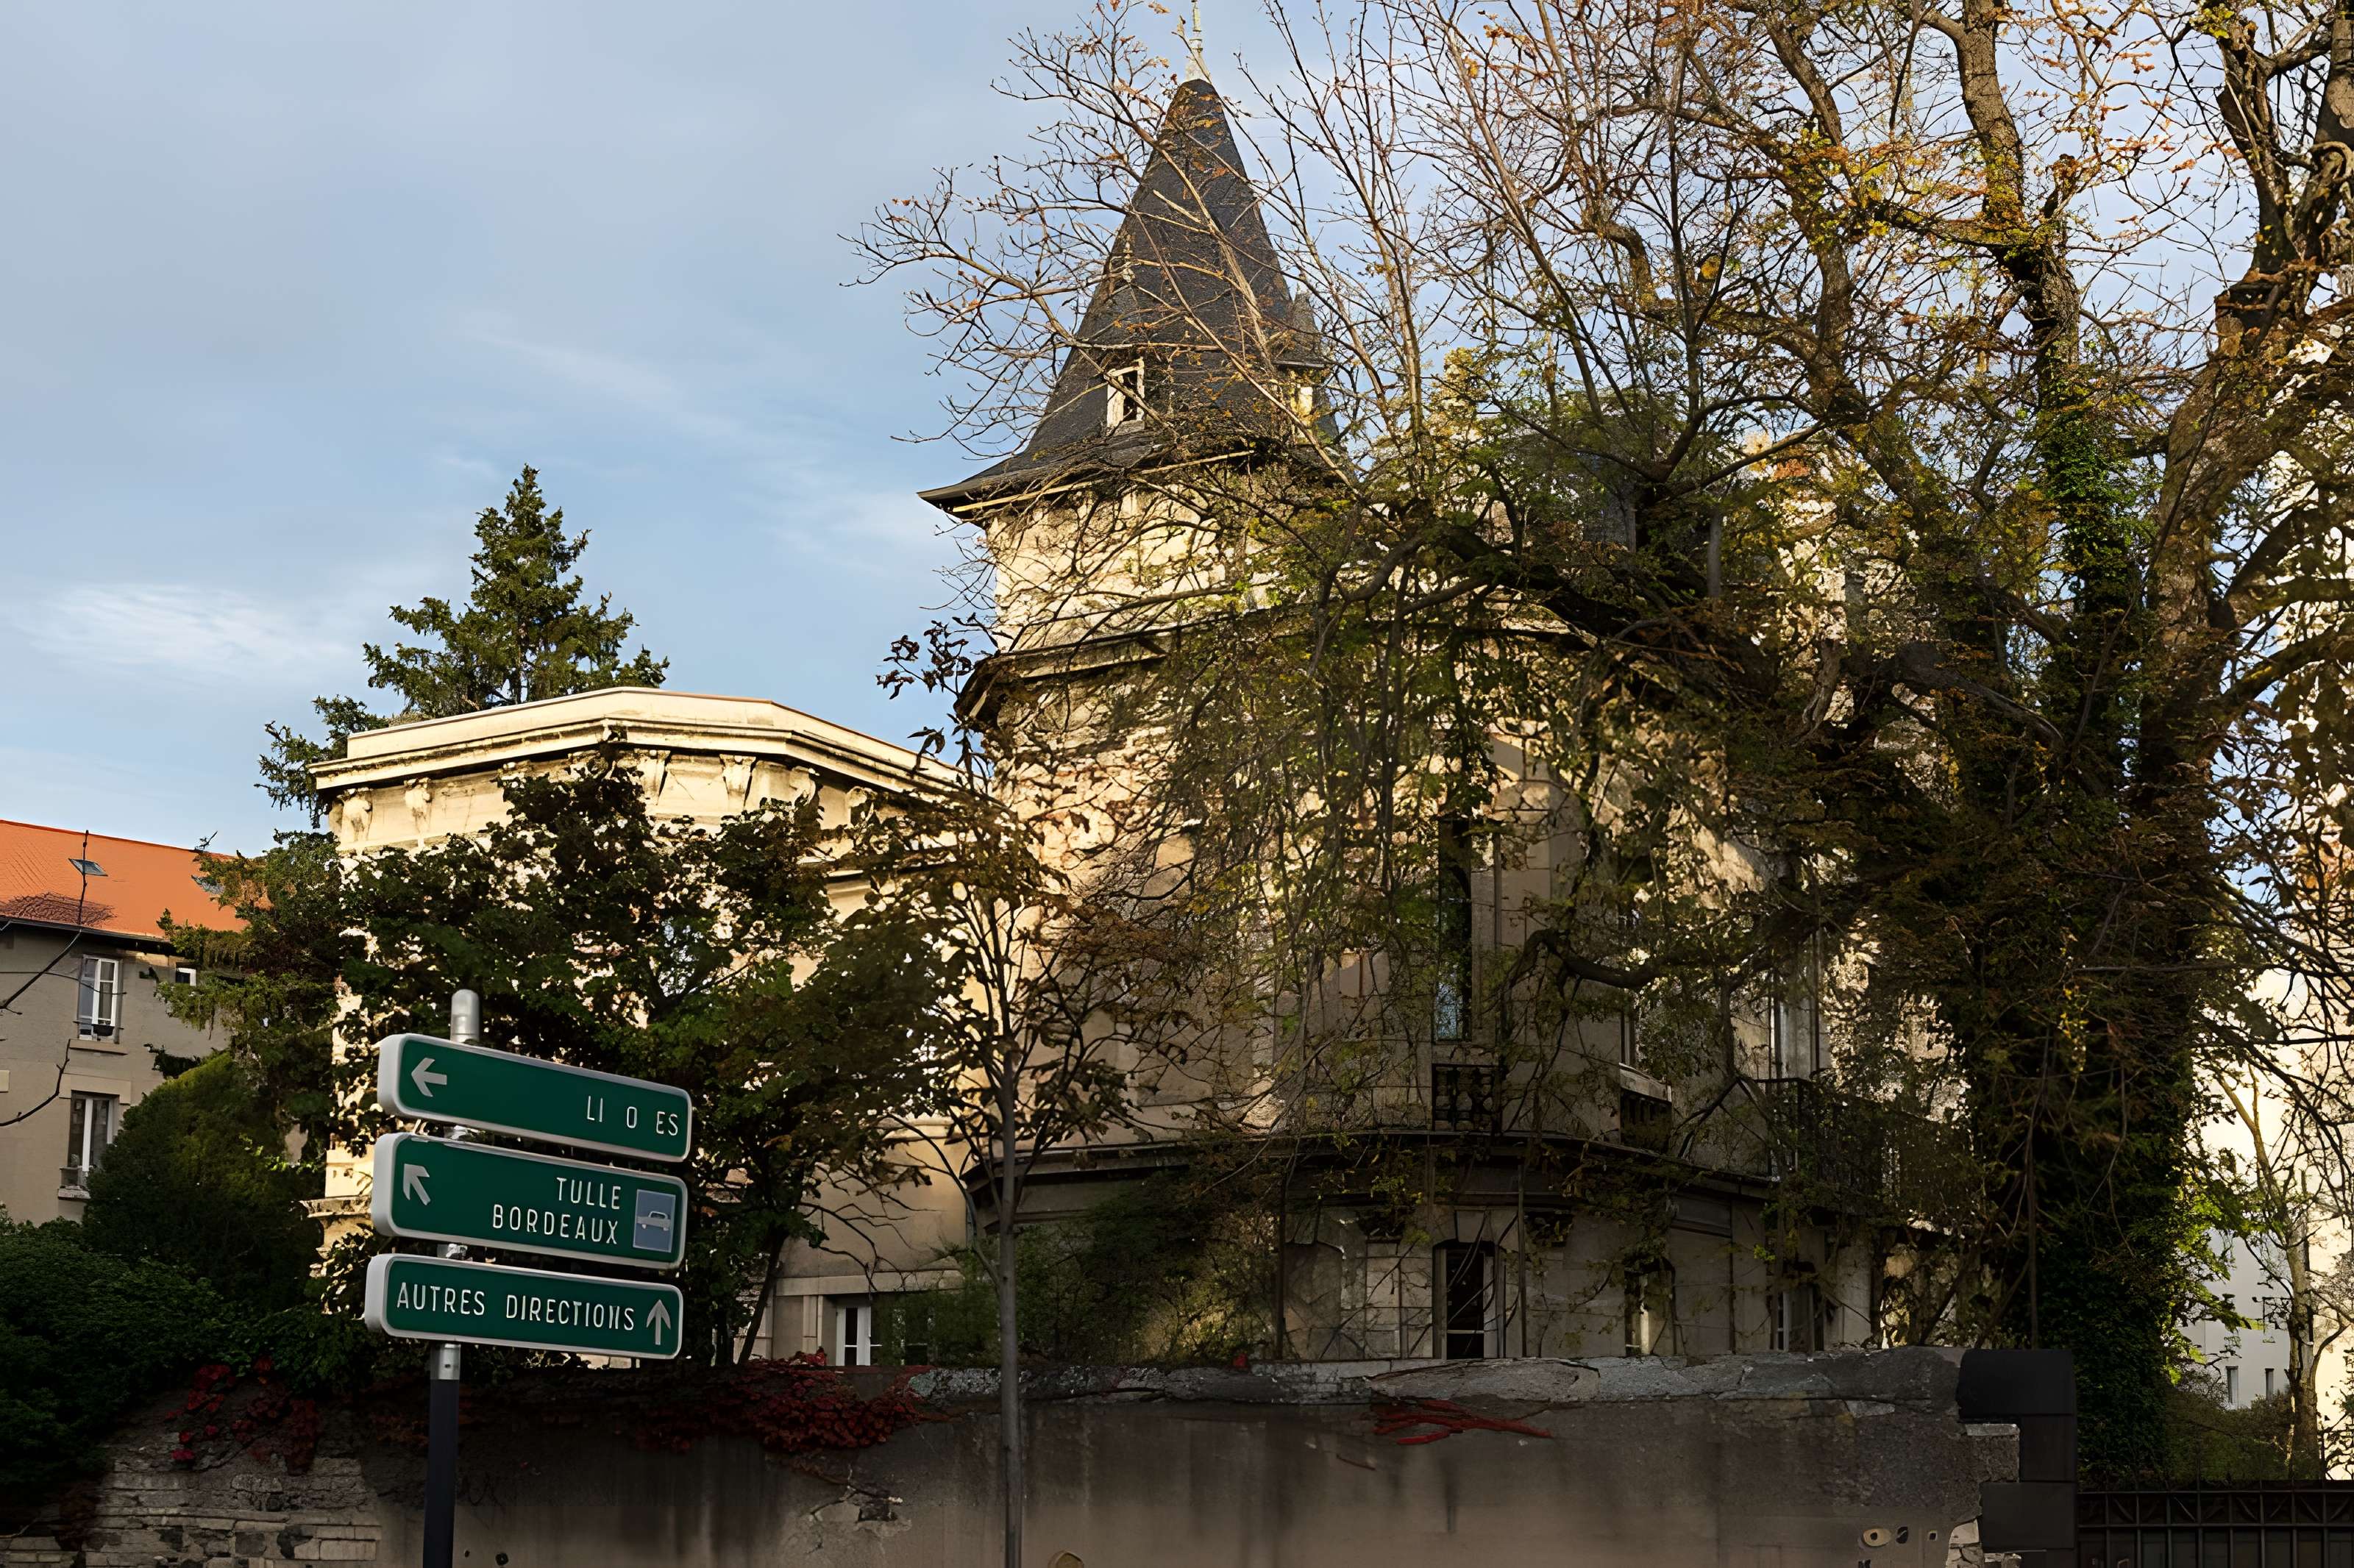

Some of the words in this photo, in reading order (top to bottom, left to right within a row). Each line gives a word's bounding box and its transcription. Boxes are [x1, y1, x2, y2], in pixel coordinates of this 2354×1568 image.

[586, 1094, 679, 1137] LIOES
[555, 1176, 622, 1211] TULLE
[491, 1202, 619, 1245] BORDEAUX
[396, 1281, 486, 1316] AUTRES
[505, 1293, 635, 1332] DIRECTIONS
